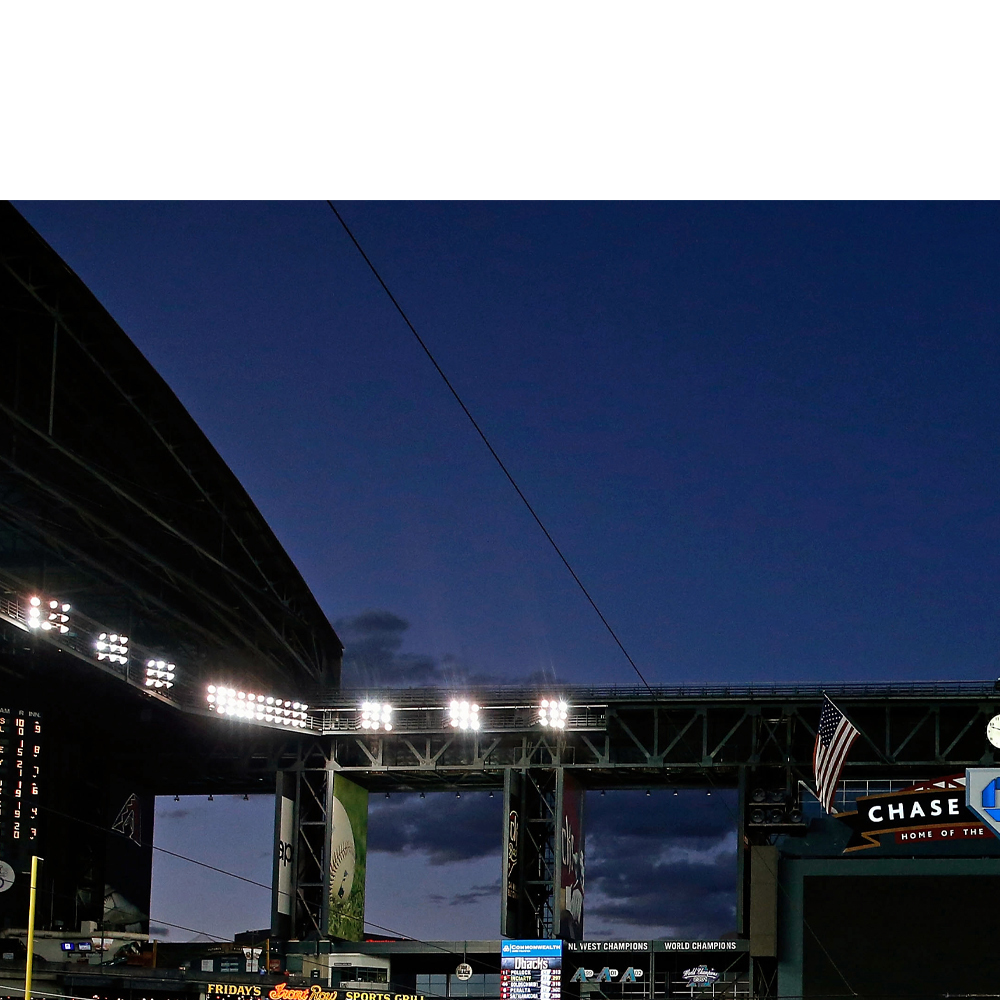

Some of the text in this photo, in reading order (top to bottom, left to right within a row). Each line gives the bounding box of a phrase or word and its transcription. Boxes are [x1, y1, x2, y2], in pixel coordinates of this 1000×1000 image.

[16, 719, 24, 727] 10
[868, 799, 960, 822] CHASE
[901, 830, 932, 840] HOME
[963, 828, 984, 836] THE
[604, 942, 648, 950] CHAMPIONS
[691, 942, 736, 950] CHAMPIONS
[207, 984, 261, 996] FRIDAY'S
[269, 982, 309, 1000] Front
